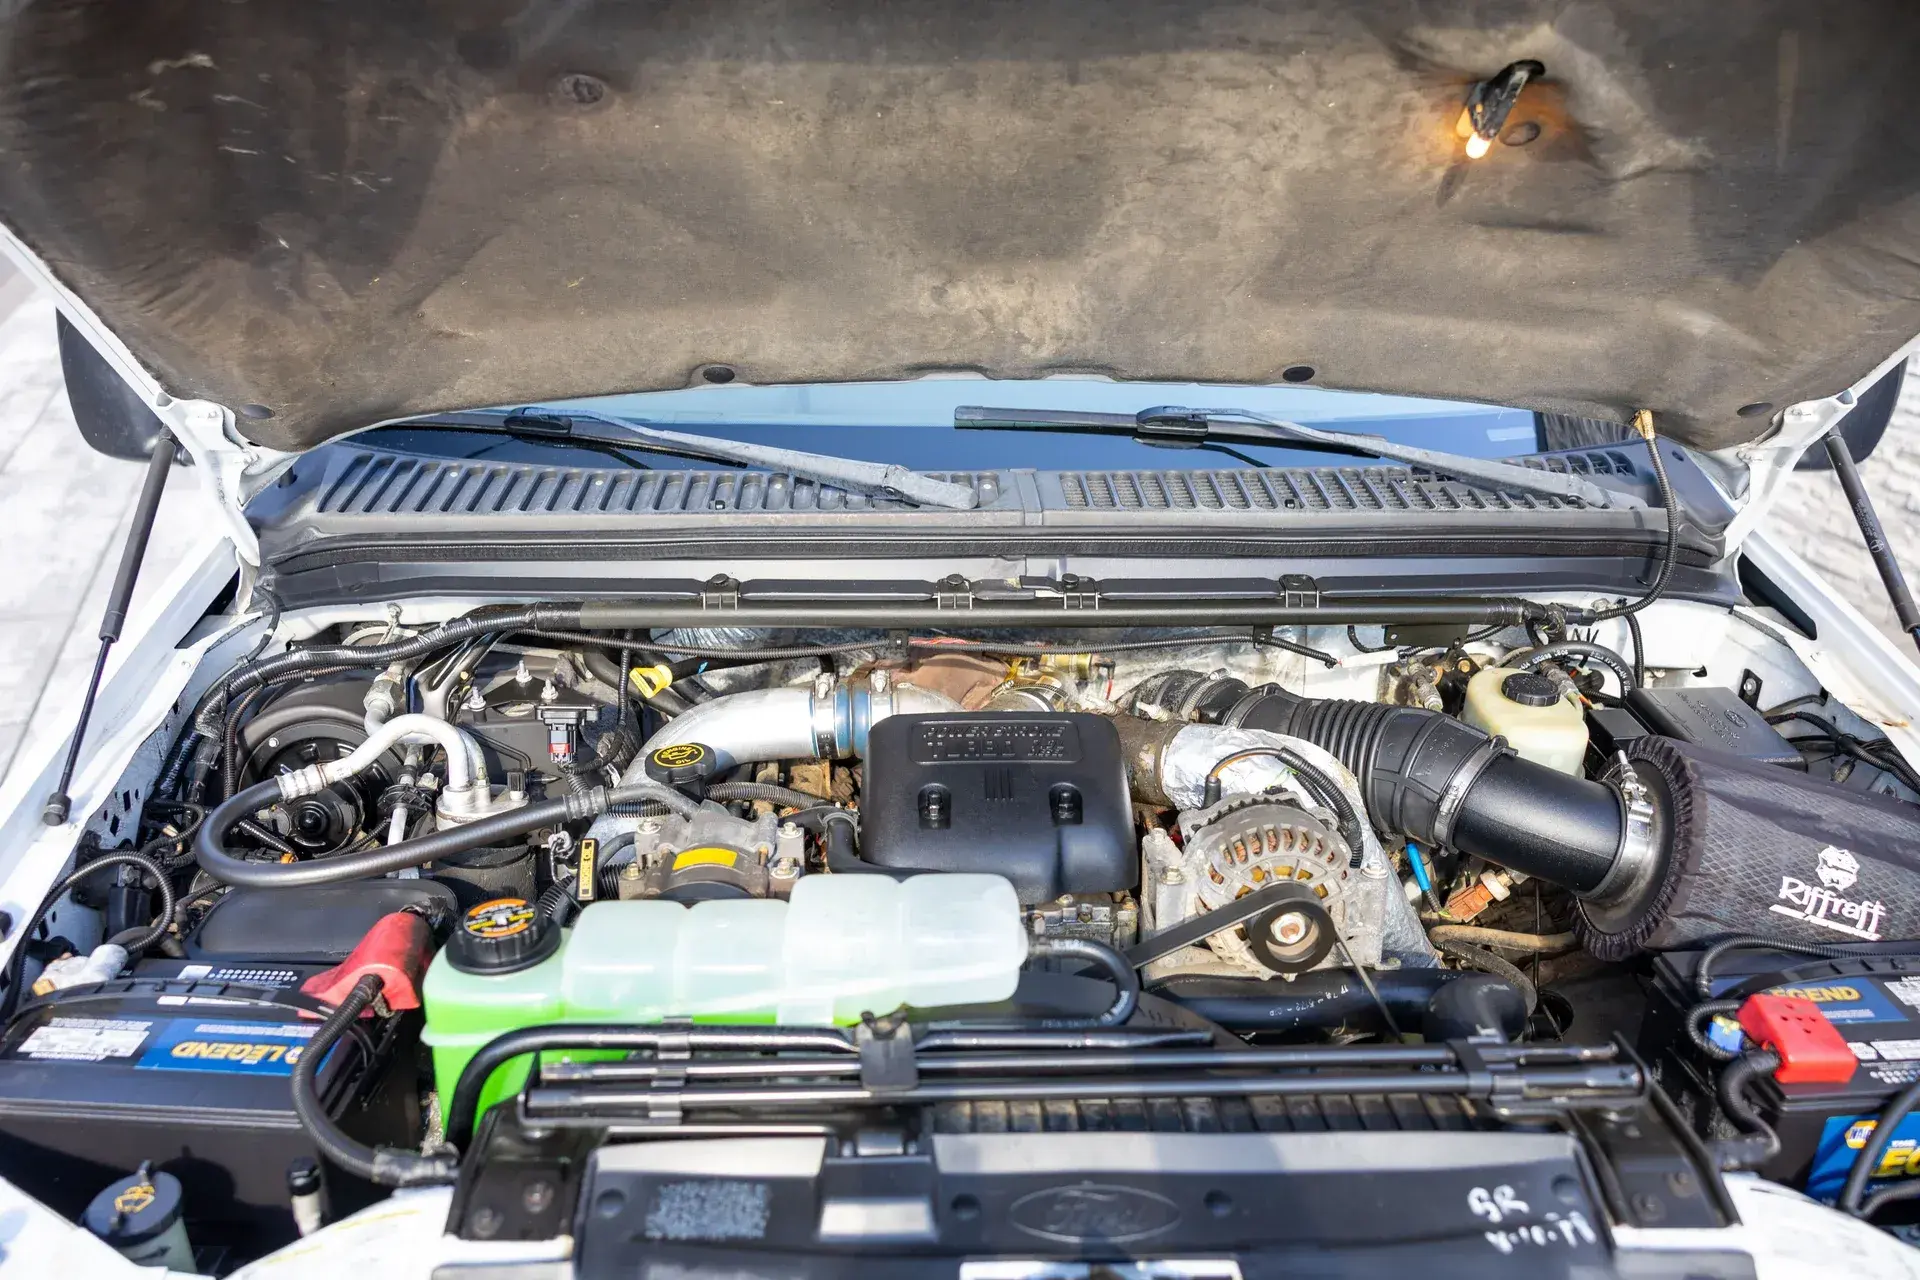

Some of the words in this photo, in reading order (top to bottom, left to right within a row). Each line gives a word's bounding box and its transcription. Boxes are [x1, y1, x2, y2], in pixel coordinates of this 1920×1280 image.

[1778, 875, 1887, 934] Riffraff
[1769, 986, 1862, 1002] EGEND
[171, 1040, 288, 1062] LEGEND
